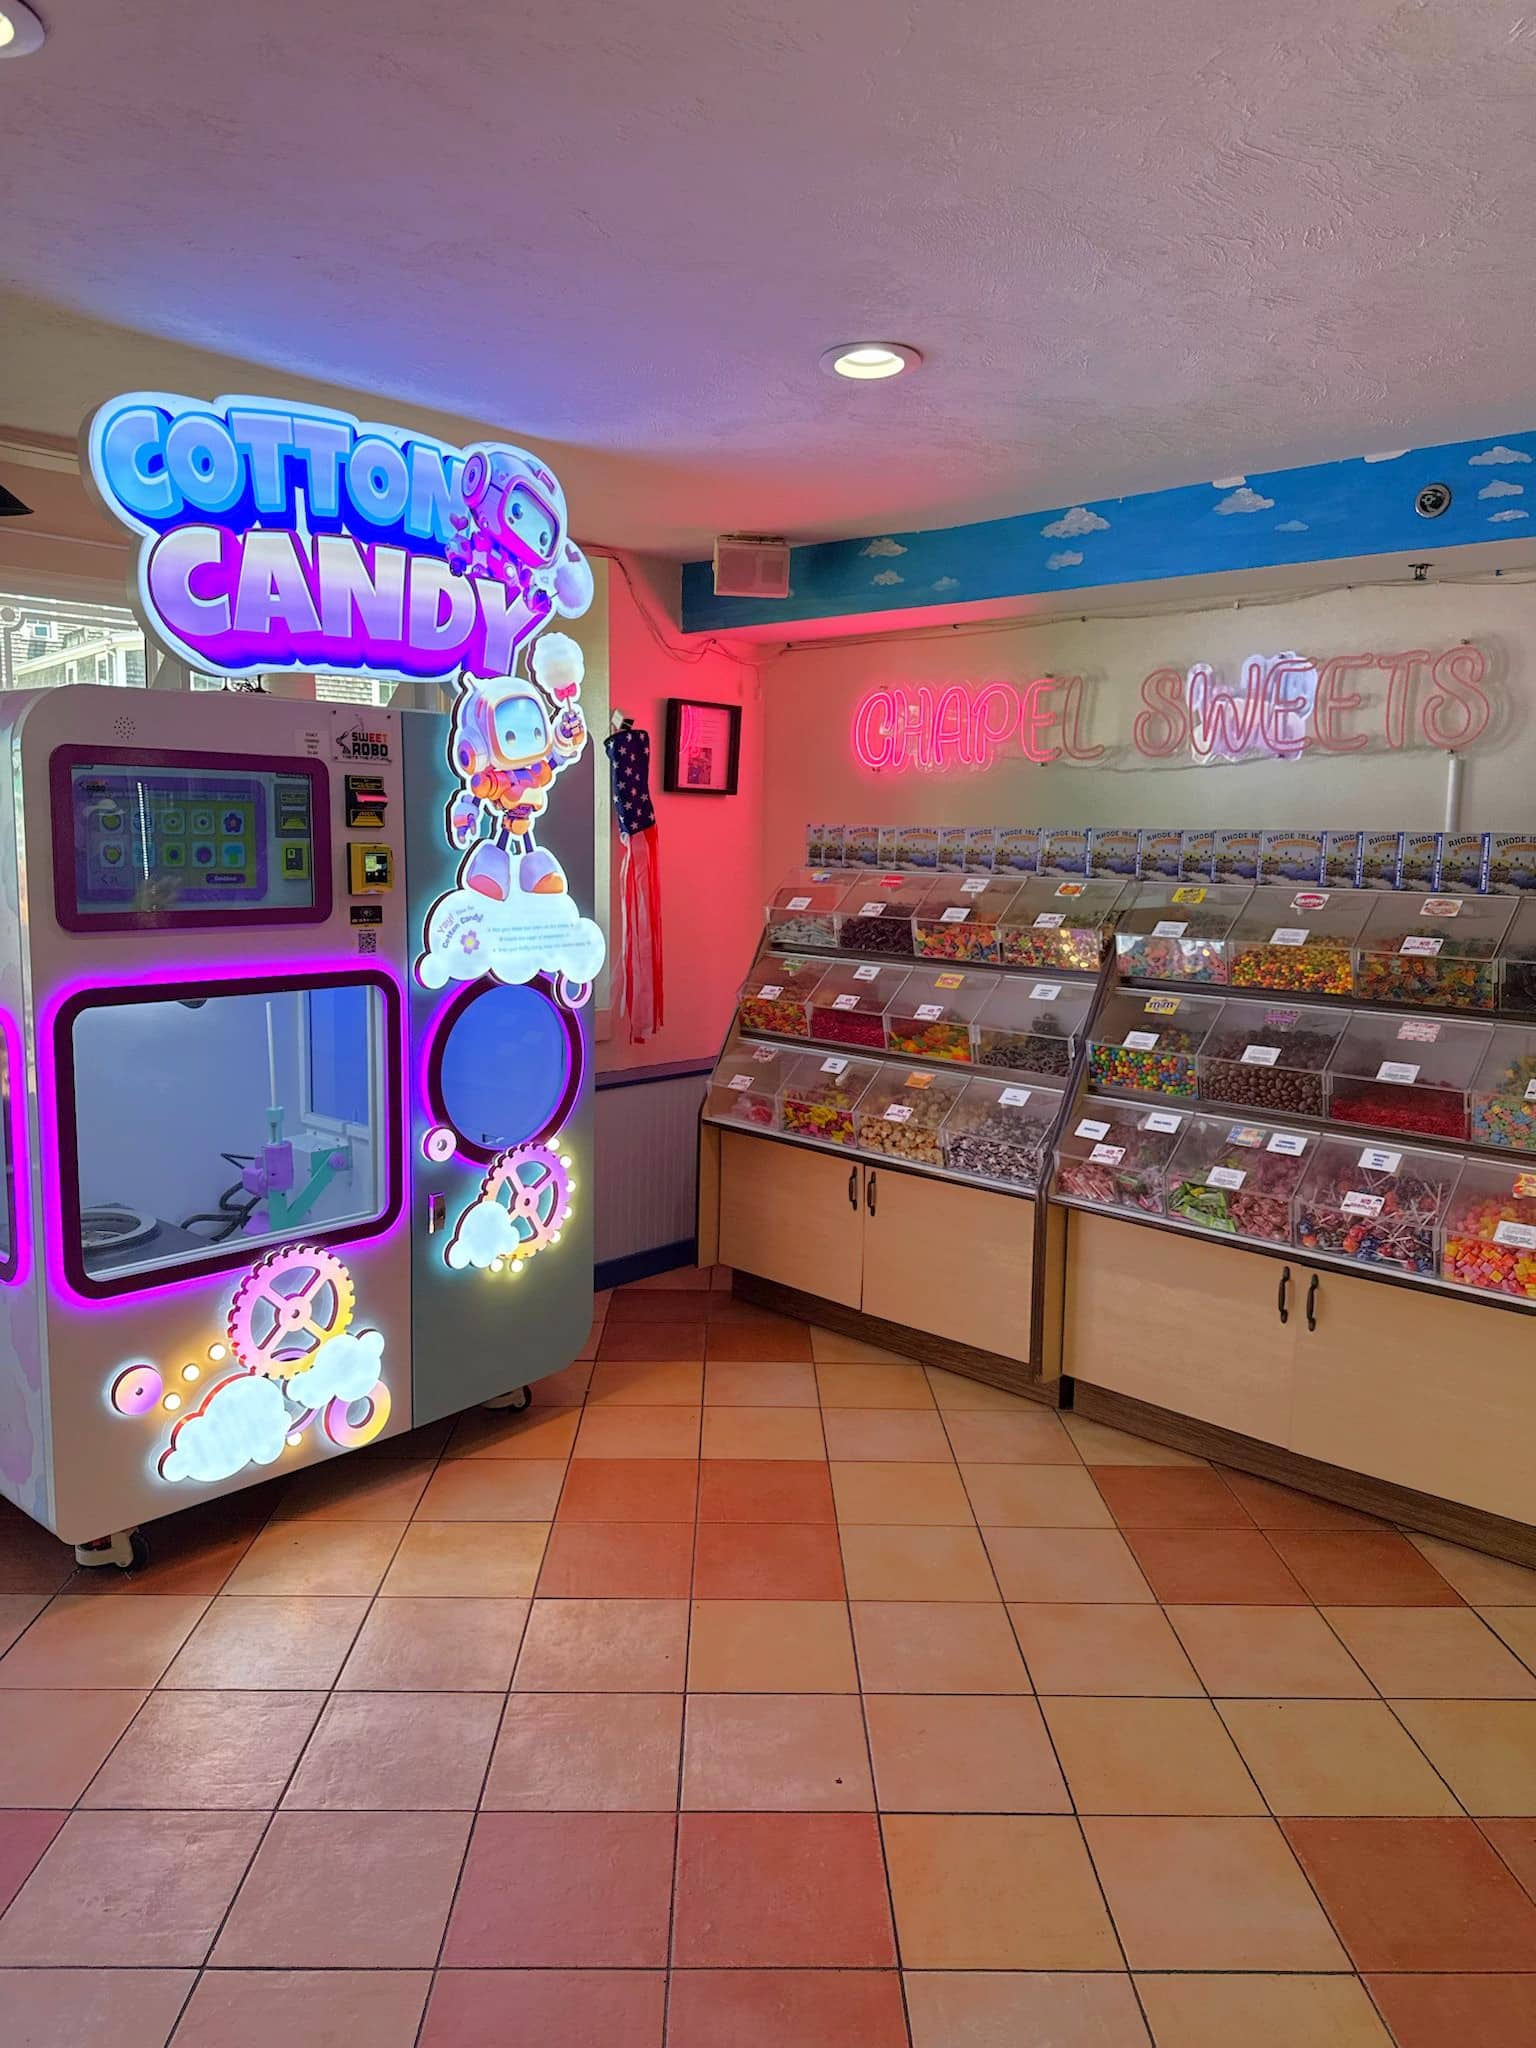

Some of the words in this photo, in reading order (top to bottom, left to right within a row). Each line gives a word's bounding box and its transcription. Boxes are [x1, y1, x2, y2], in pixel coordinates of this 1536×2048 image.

[102, 405, 470, 544] COTTON
[148, 523, 540, 679] CANDY
[351, 731, 389, 743] SWEET
[351, 742, 389, 757] ROBO
[855, 672, 1105, 768] CHAPEL
[1132, 645, 1491, 757] SWEETS
